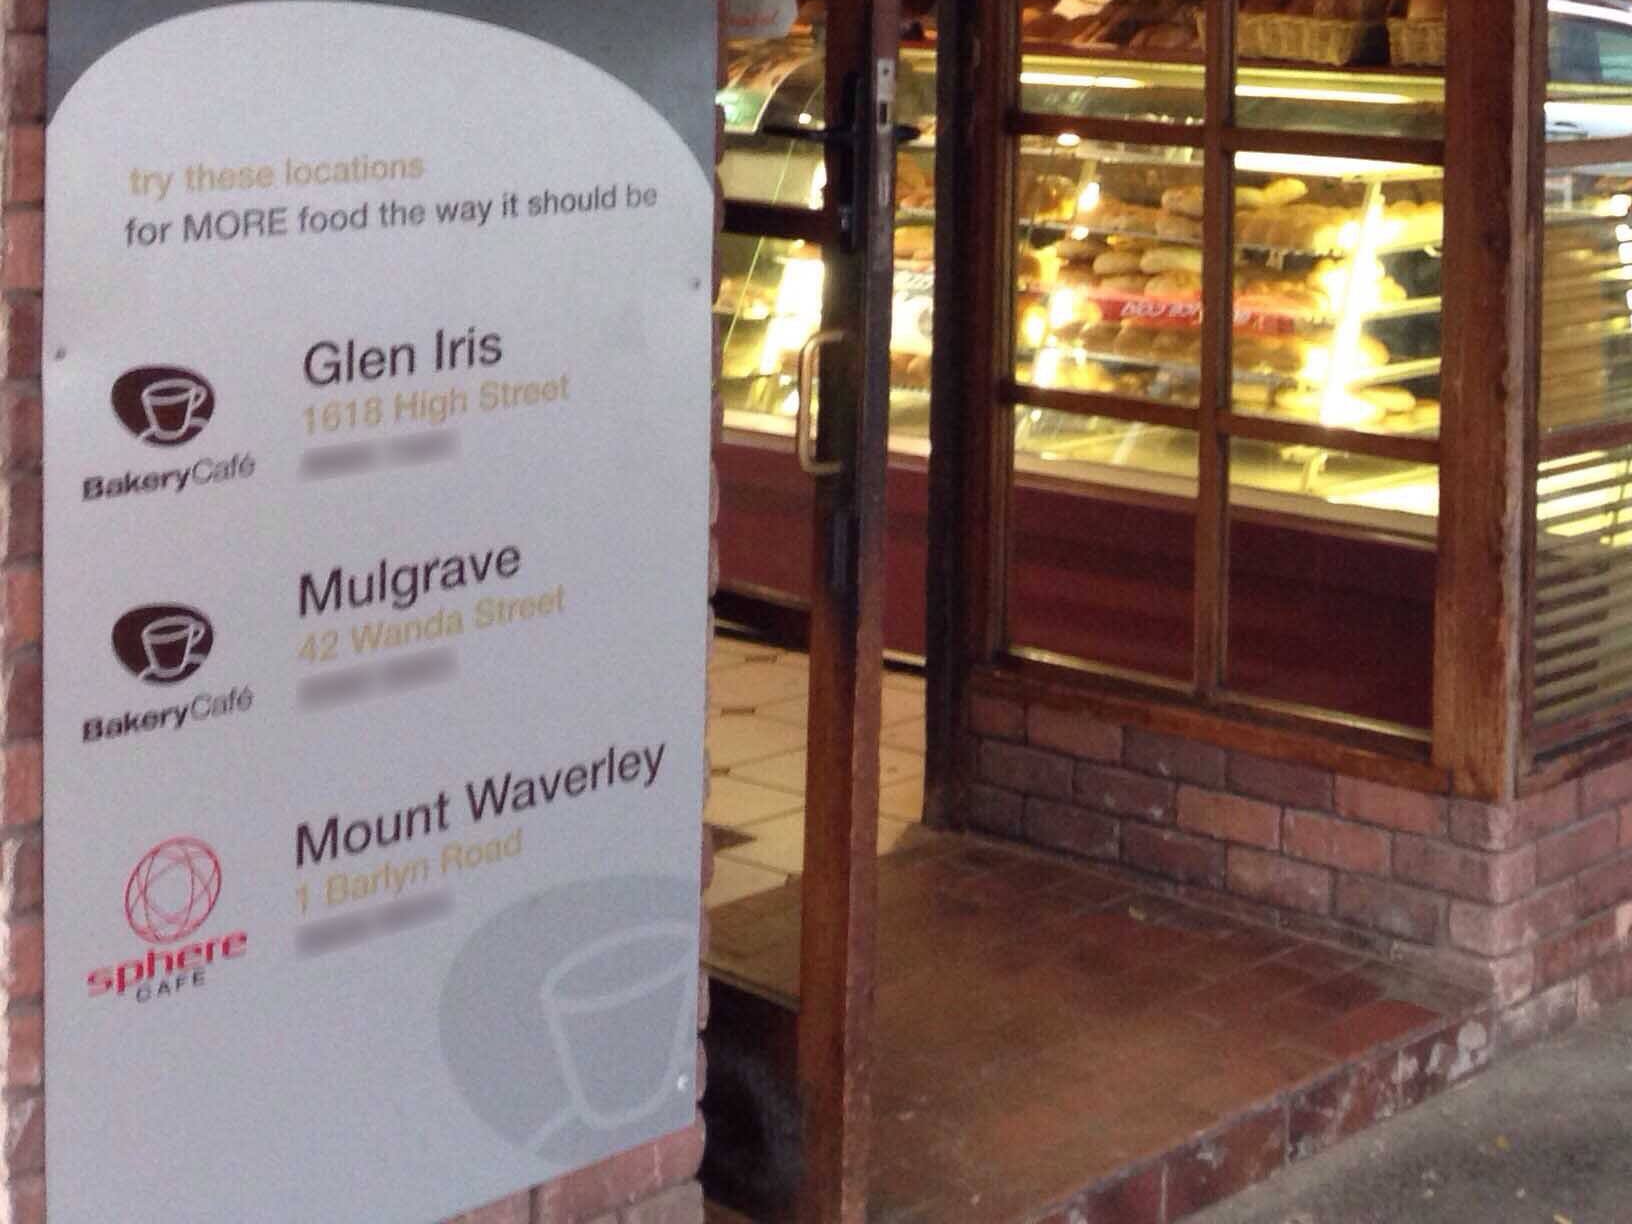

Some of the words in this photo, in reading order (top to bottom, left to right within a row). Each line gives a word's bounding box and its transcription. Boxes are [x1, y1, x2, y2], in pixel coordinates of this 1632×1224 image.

[128, 166, 173, 200] try
[184, 162, 275, 194] these
[284, 153, 425, 187] locations
[124, 215, 172, 247] for
[181, 206, 288, 244] MORE
[298, 201, 369, 234] food
[377, 197, 425, 228] the
[434, 199, 492, 226] way
[501, 191, 519, 219] it
[526, 183, 618, 218] should
[626, 183, 658, 209] be
[303, 334, 415, 386] Glen
[434, 327, 503, 370] Iris
[304, 395, 384, 435] 1618
[393, 386, 469, 426] High
[479, 375, 570, 412] Street
[299, 544, 522, 619] Mulgrave
[298, 631, 339, 664] 42
[350, 607, 464, 654] Wanda
[472, 584, 566, 630] Street
[295, 790, 450, 869] Mount
[465, 742, 667, 822] Waverley
[439, 829, 524, 873] Road
[87, 930, 248, 997] sphere
[136, 969, 207, 1003] CAFE
